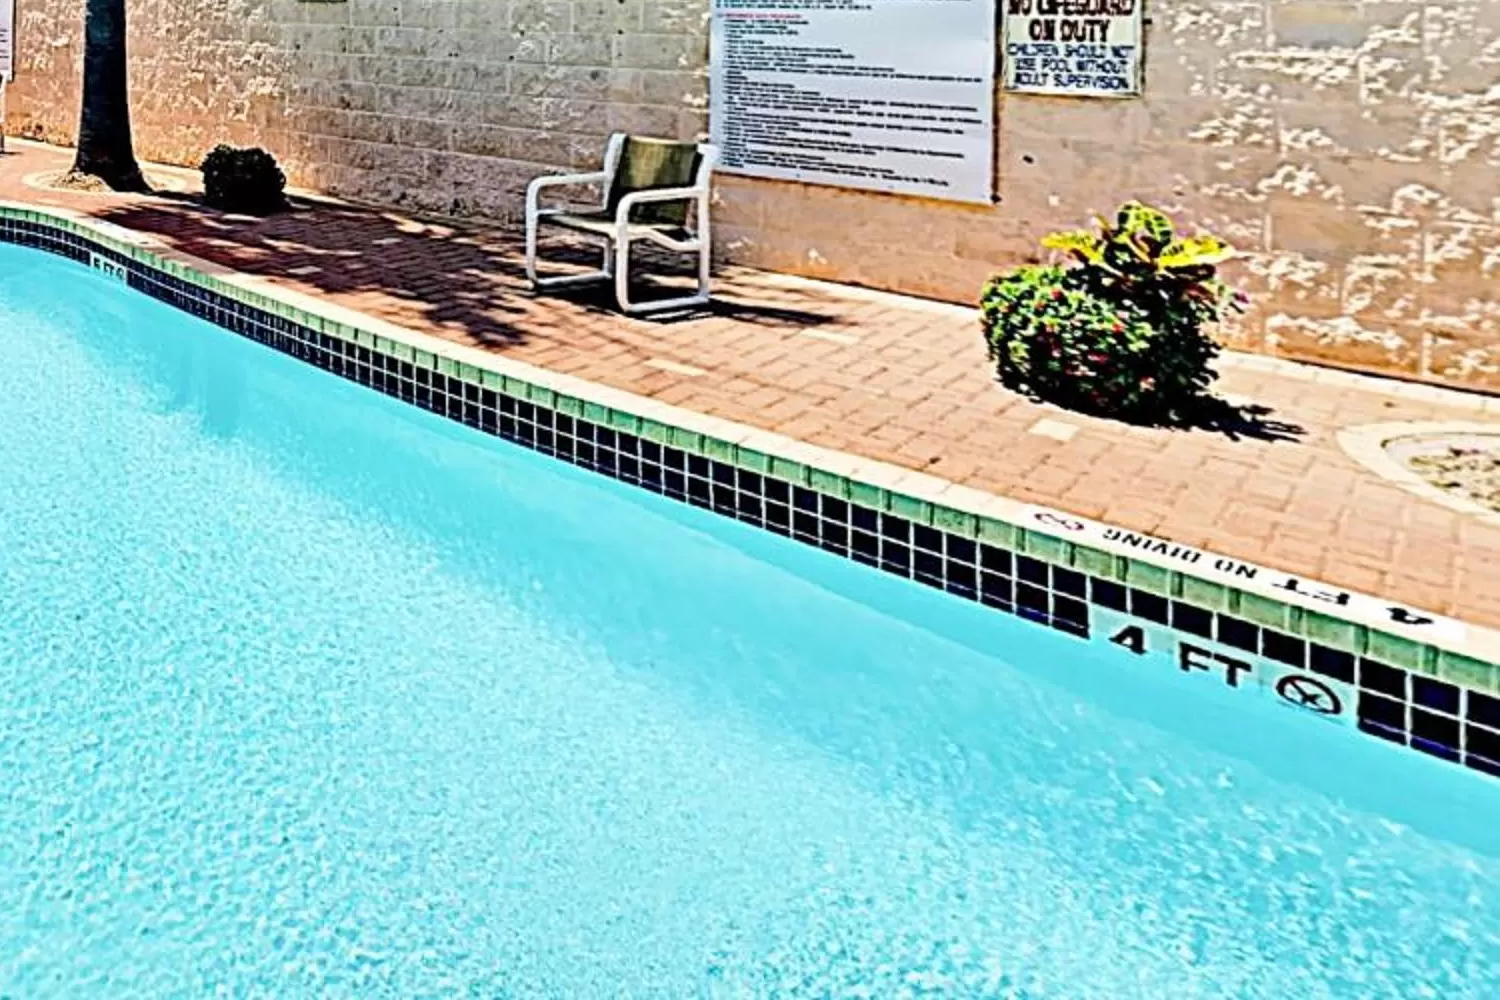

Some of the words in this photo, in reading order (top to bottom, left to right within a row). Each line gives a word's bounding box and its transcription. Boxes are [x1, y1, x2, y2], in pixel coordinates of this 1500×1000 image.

[1029, 18, 1055, 42] ON
[1060, 18, 1111, 43] DUTY
[1041, 58, 1073, 73] POOL
[1076, 59, 1128, 74] WITHOUT
[1102, 528, 1202, 564] DIVING
[1214, 559, 1259, 579] NO
[1271, 578, 1351, 606] FT
[1385, 606, 1435, 625] 4
[1108, 625, 1148, 656] 4
[1178, 641, 1253, 688] FT
